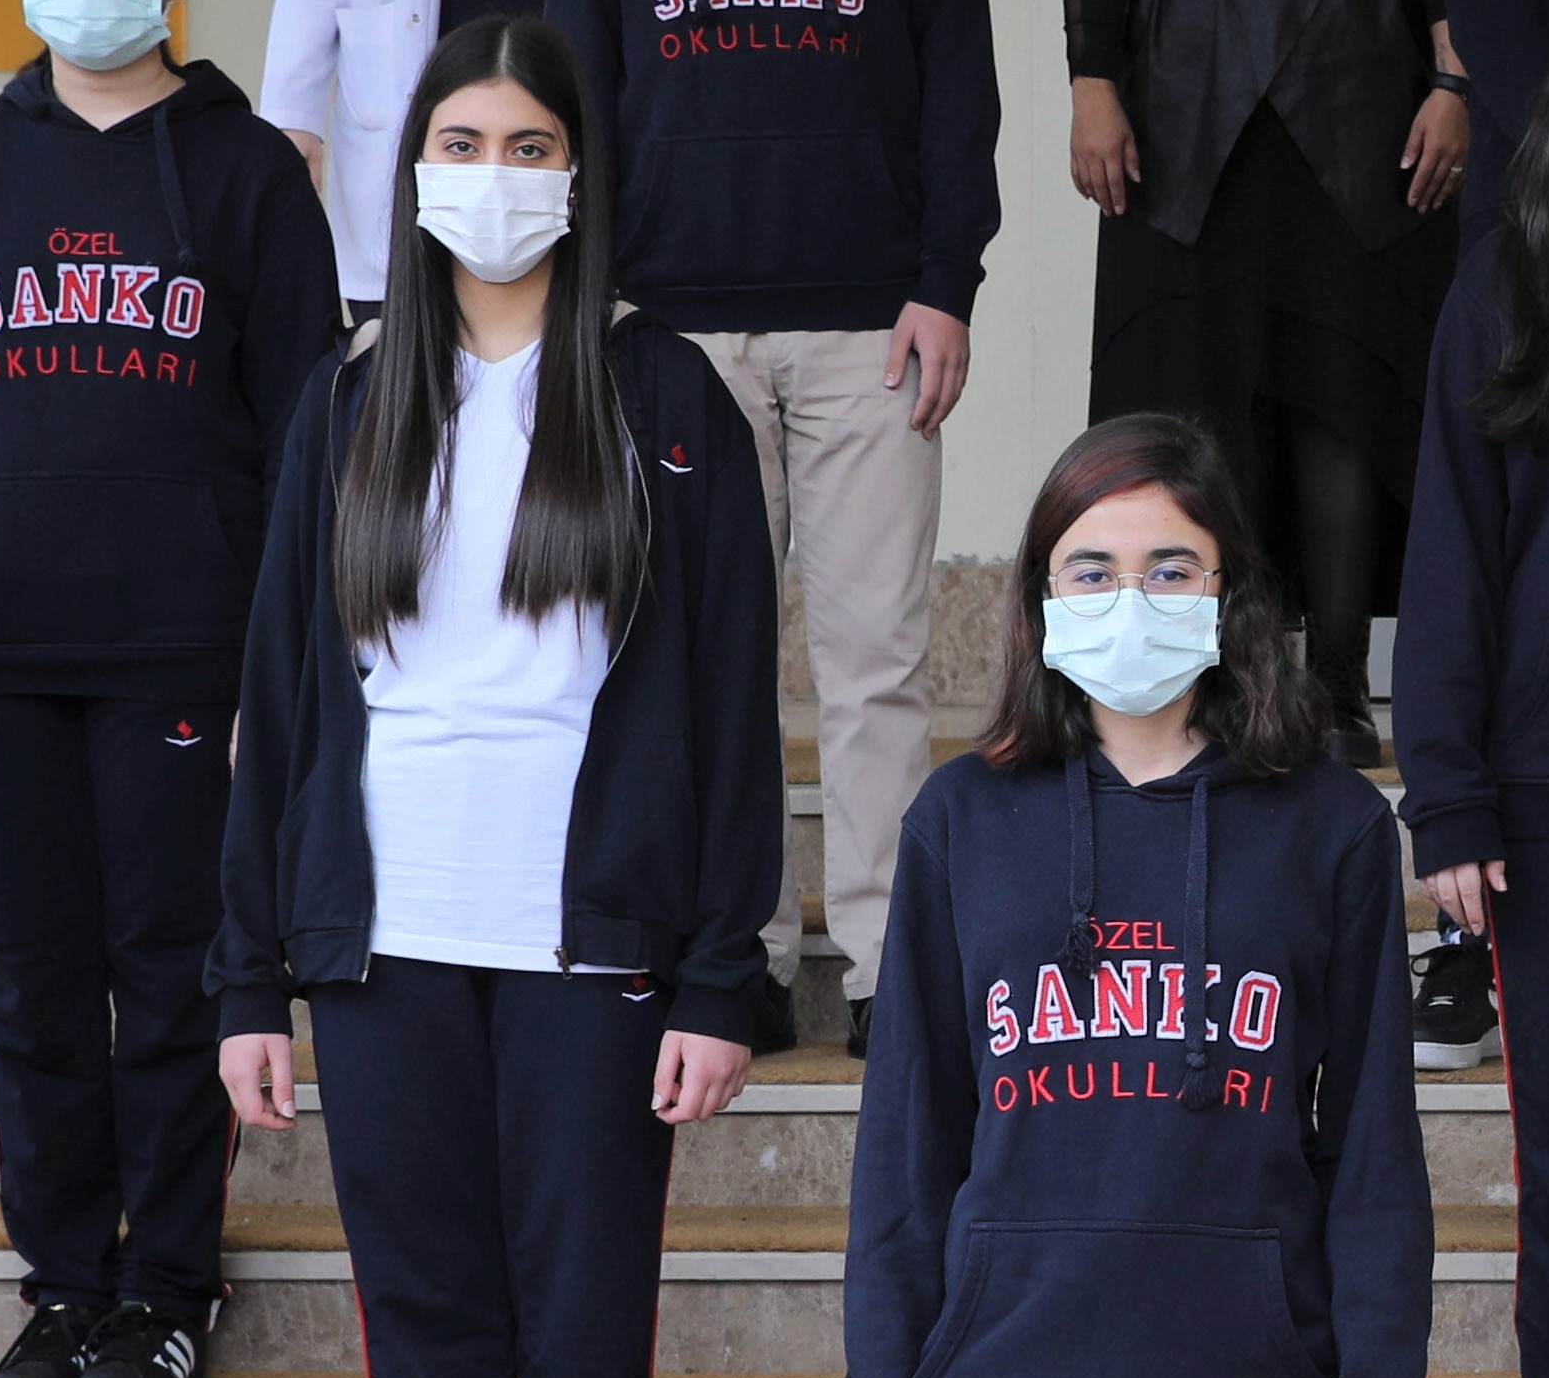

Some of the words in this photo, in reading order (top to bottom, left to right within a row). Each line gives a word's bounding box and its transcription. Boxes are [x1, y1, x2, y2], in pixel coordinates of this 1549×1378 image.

[659, 23, 863, 60] OKULLARI
[48, 227, 123, 256] ÖZEL
[986, 959, 1282, 1057] SANKO
[993, 1061, 1273, 1114] OKULLRI
